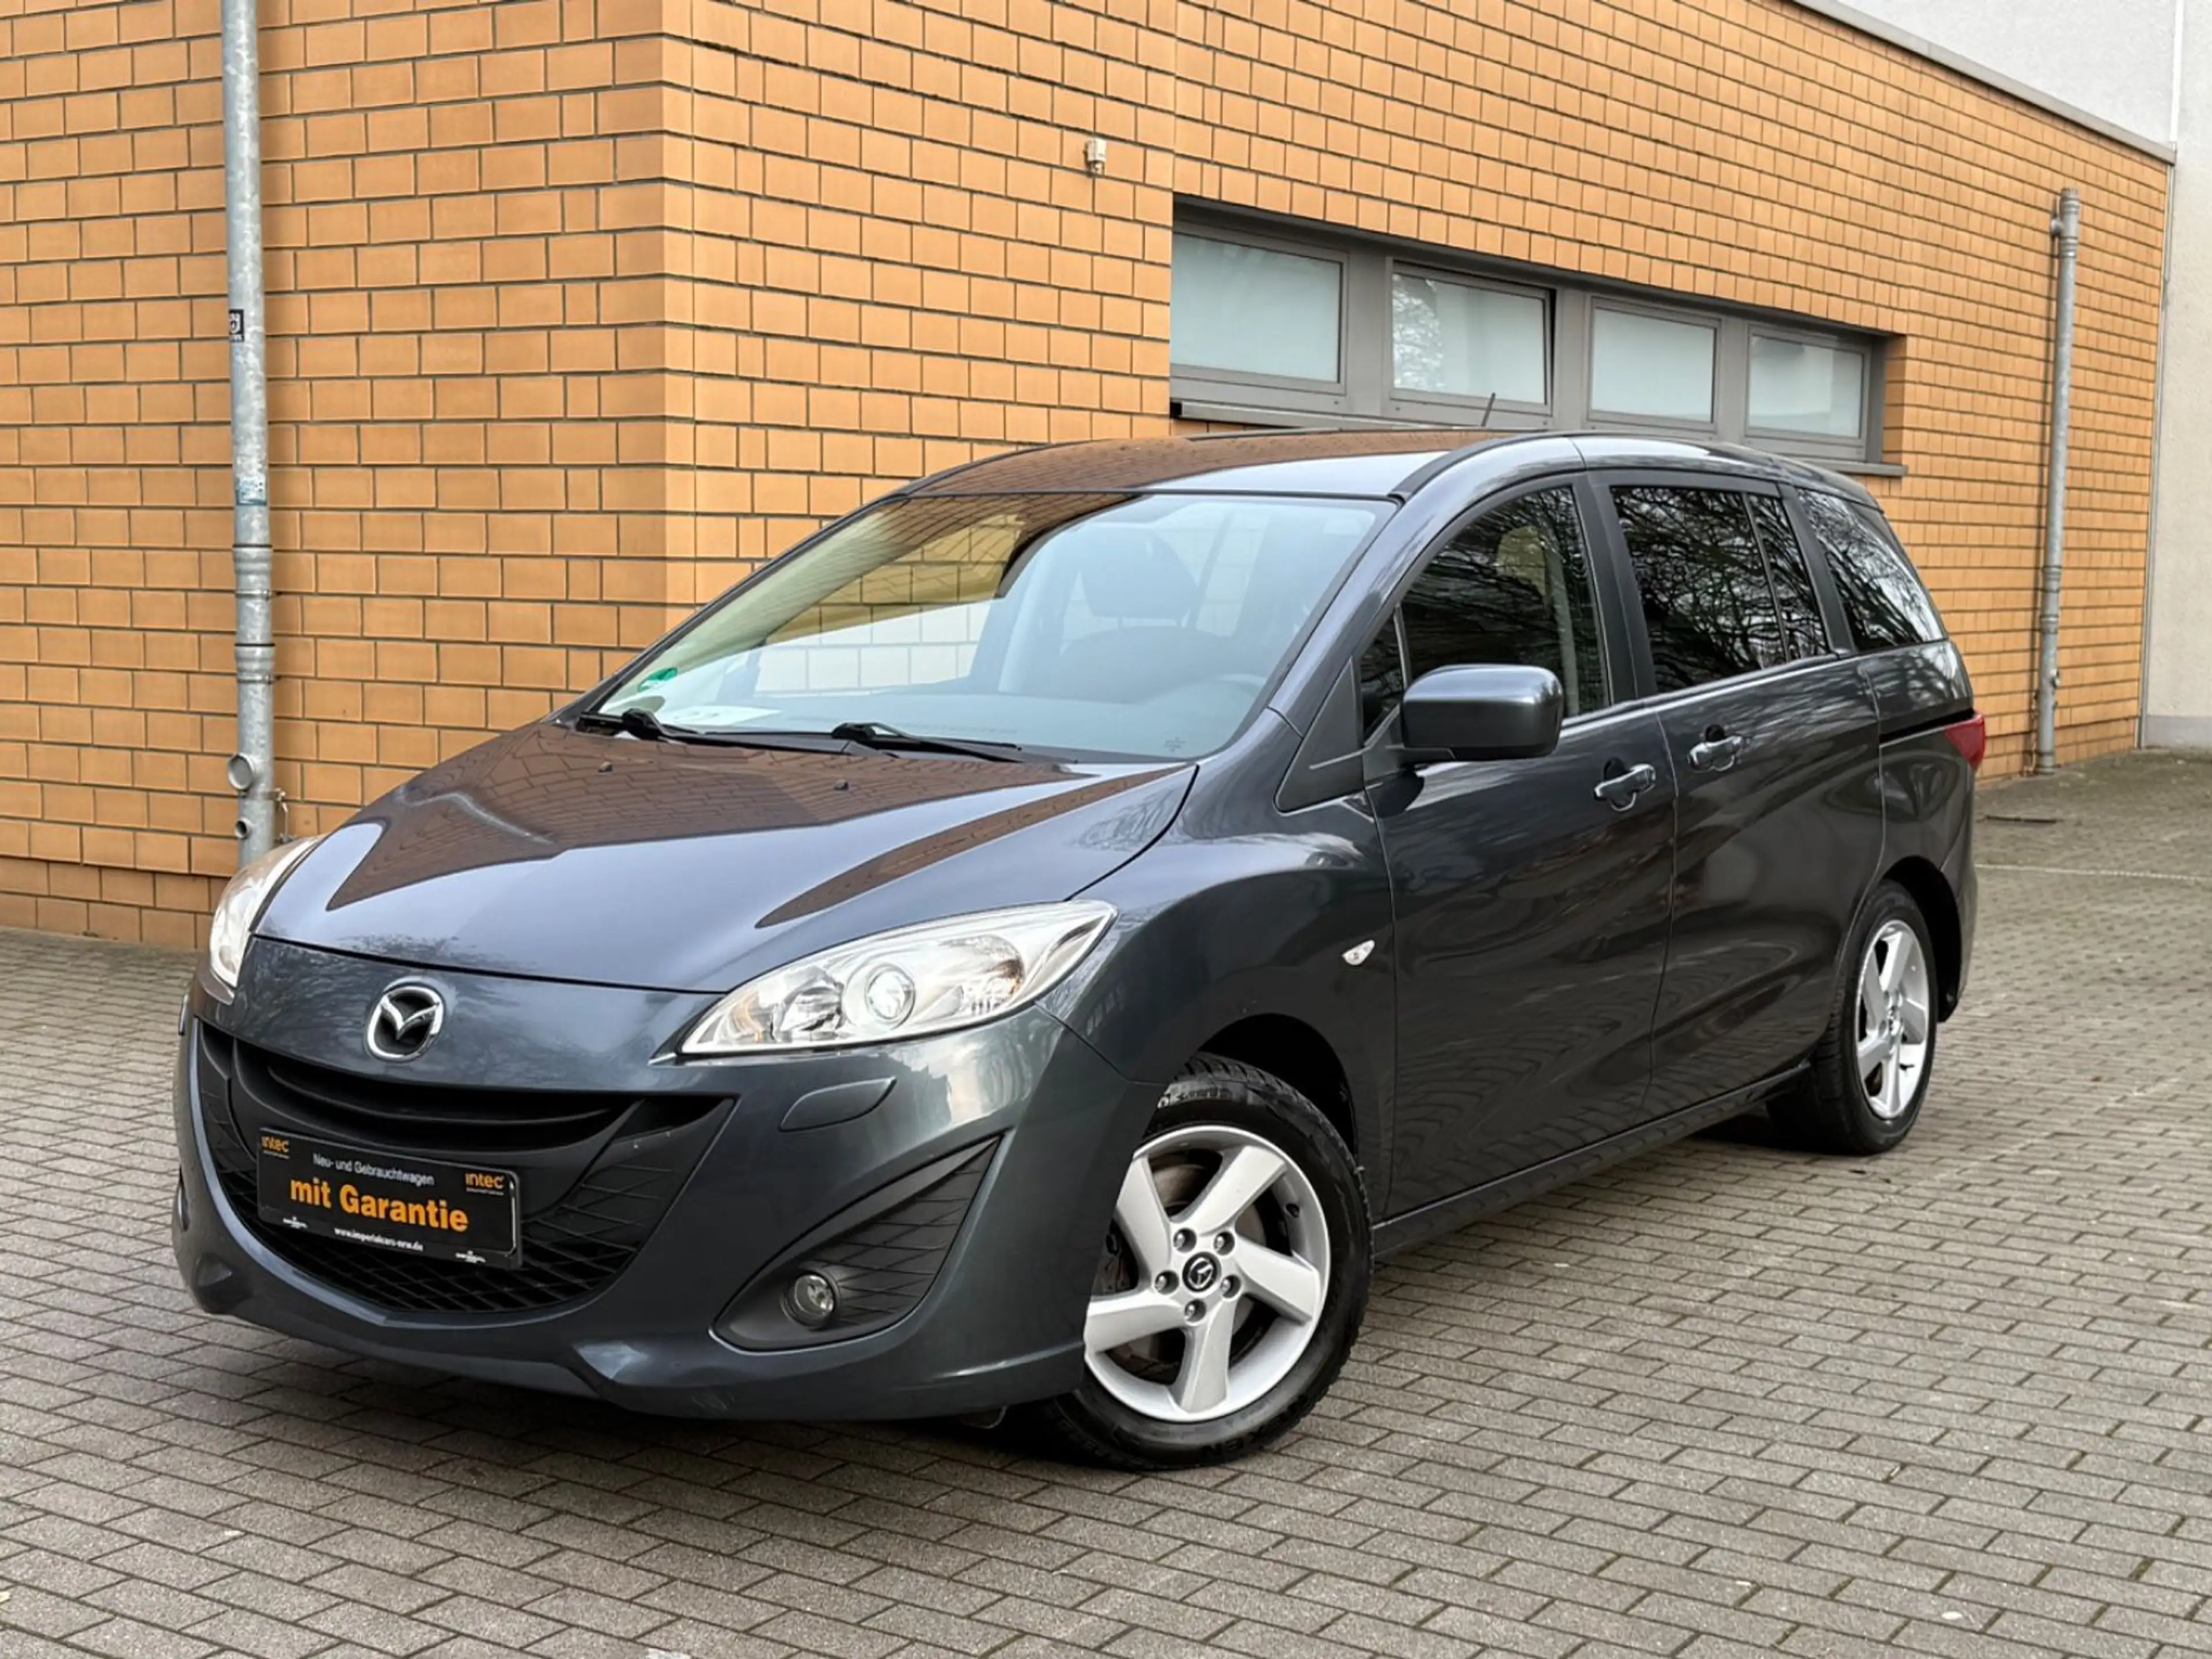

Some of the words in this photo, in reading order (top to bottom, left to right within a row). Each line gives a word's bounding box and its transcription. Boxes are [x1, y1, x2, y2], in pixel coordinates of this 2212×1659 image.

[312, 1153, 334, 1168] Neu-
[335, 1160, 353, 1173] und
[354, 1161, 435, 1187] Gebrauchtwagen
[290, 1177, 332, 1209] mit
[339, 1184, 469, 1232] Garantie
